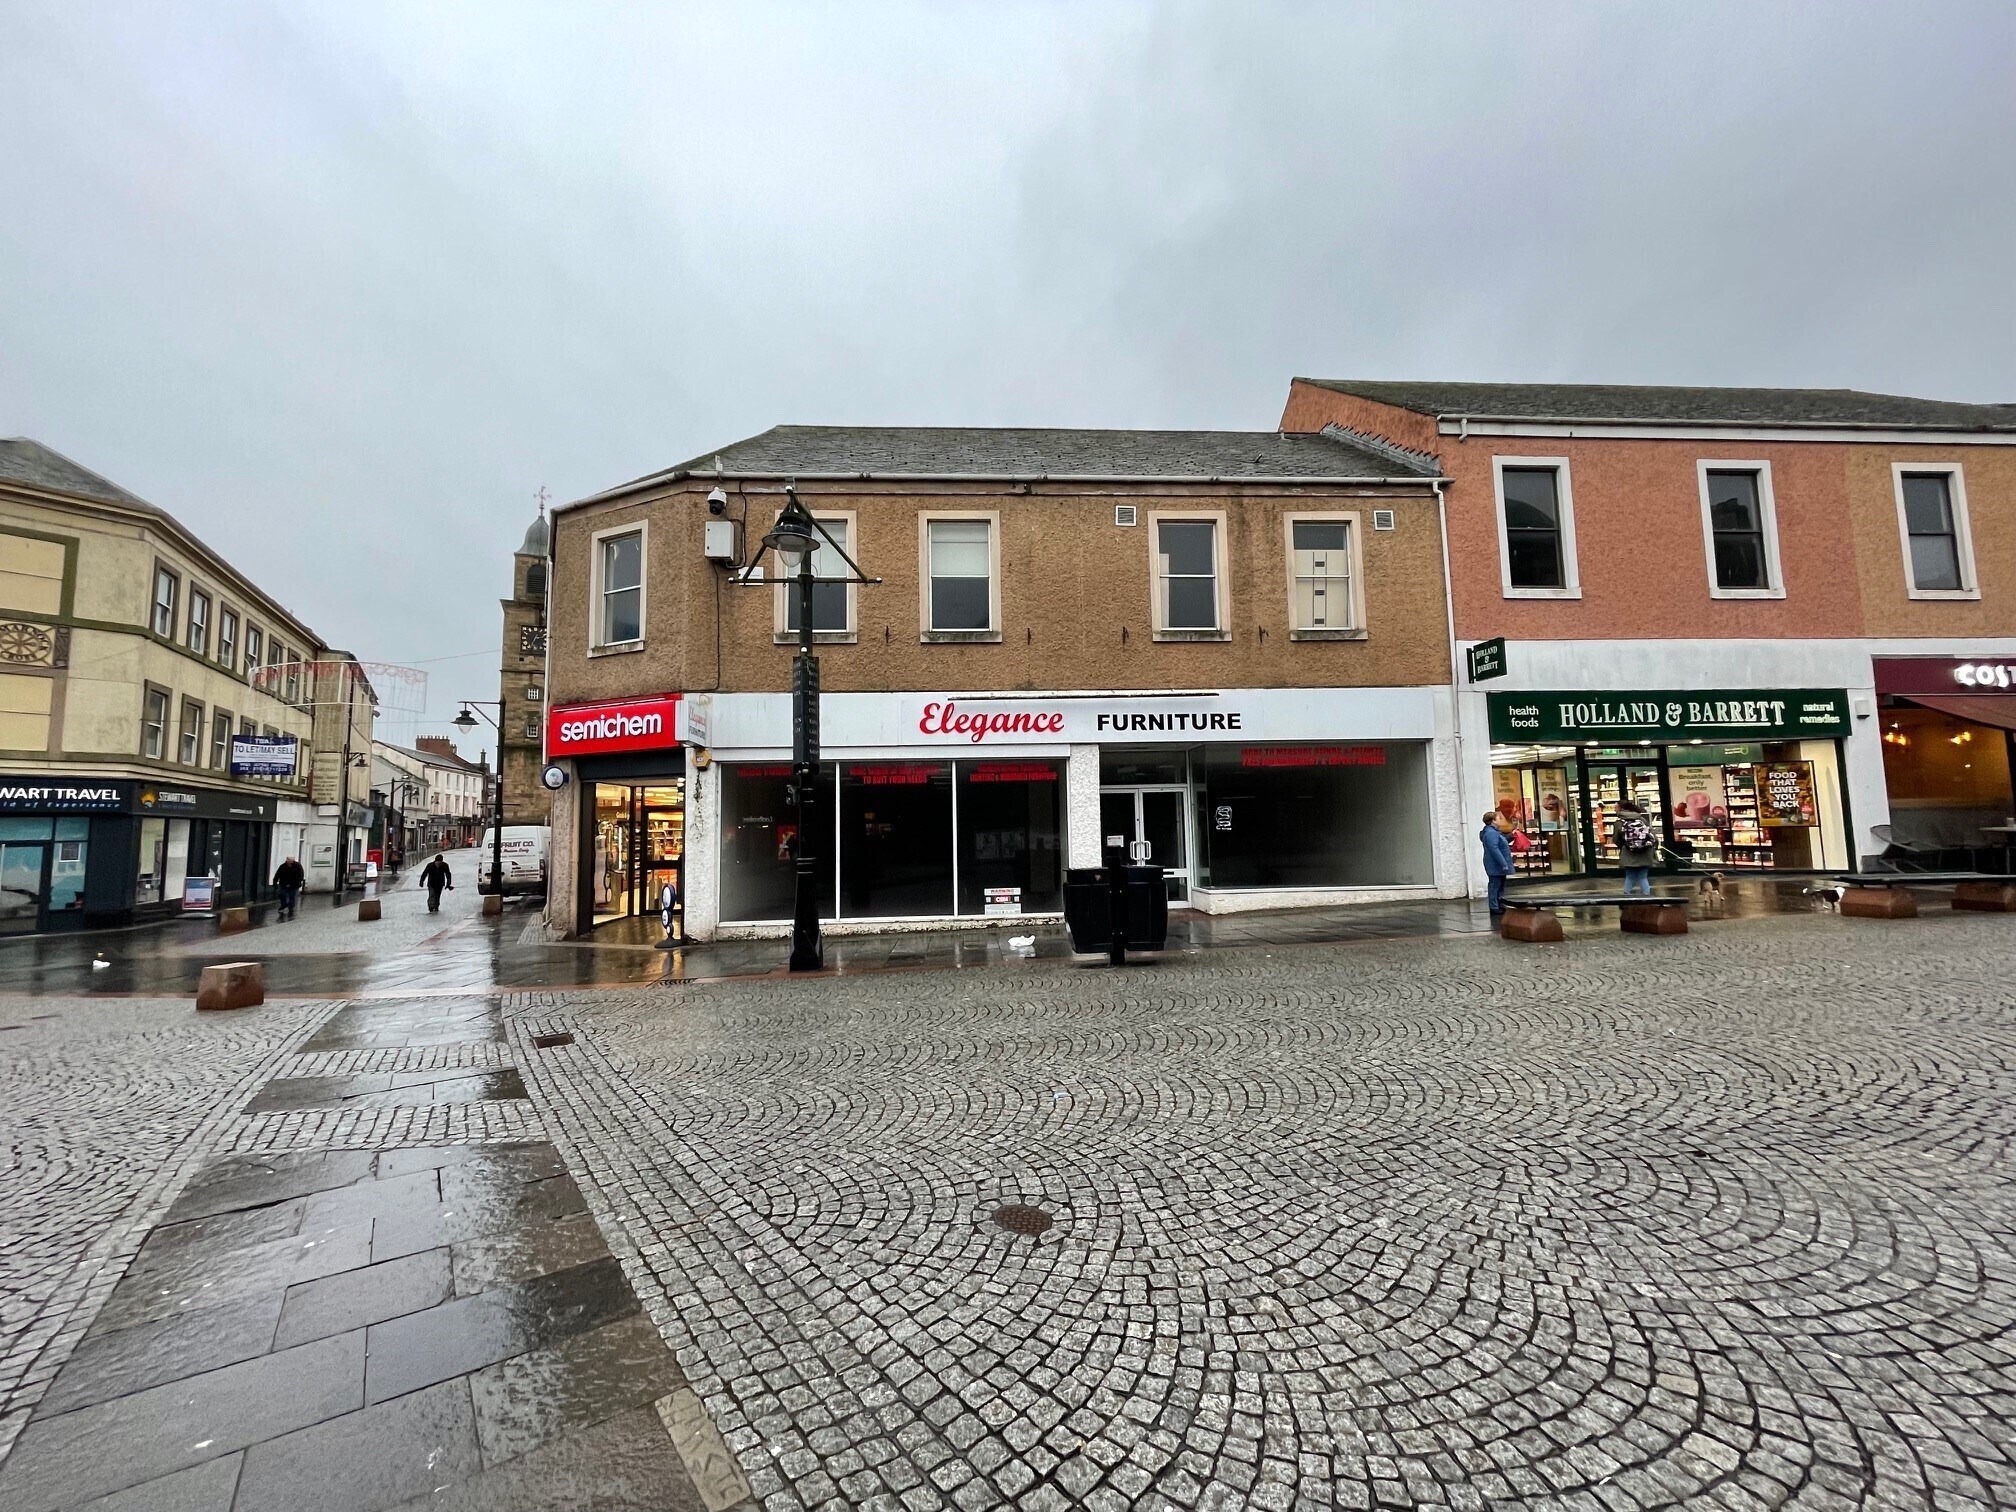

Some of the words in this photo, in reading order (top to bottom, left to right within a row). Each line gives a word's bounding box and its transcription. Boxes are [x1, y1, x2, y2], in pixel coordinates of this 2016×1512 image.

[1475, 646, 1498, 659] HOLLAND
[1477, 661, 1499, 674] BARRETT
[1509, 705, 1539, 716] health
[1802, 702, 1834, 712] natural
[1558, 702, 1660, 728] HOLLAND
[1665, 702, 1683, 727] &
[1687, 701, 1786, 726] BARRETT
[1800, 714, 1841, 724] remedies
[560, 712, 662, 742] semichem
[919, 702, 1065, 743] Elegance
[1097, 713, 1242, 731] FURNITURE
[1511, 718, 1539, 728] foods
[234, 745, 244, 753] TO
[277, 746, 295, 755] SELL
[1769, 771, 1797, 779] FOOD
[54, 788, 121, 800] TRAVEL
[1769, 786, 1800, 794] LOVES
[1775, 793, 1796, 801] YOU
[1773, 800, 1800, 808] BACK
